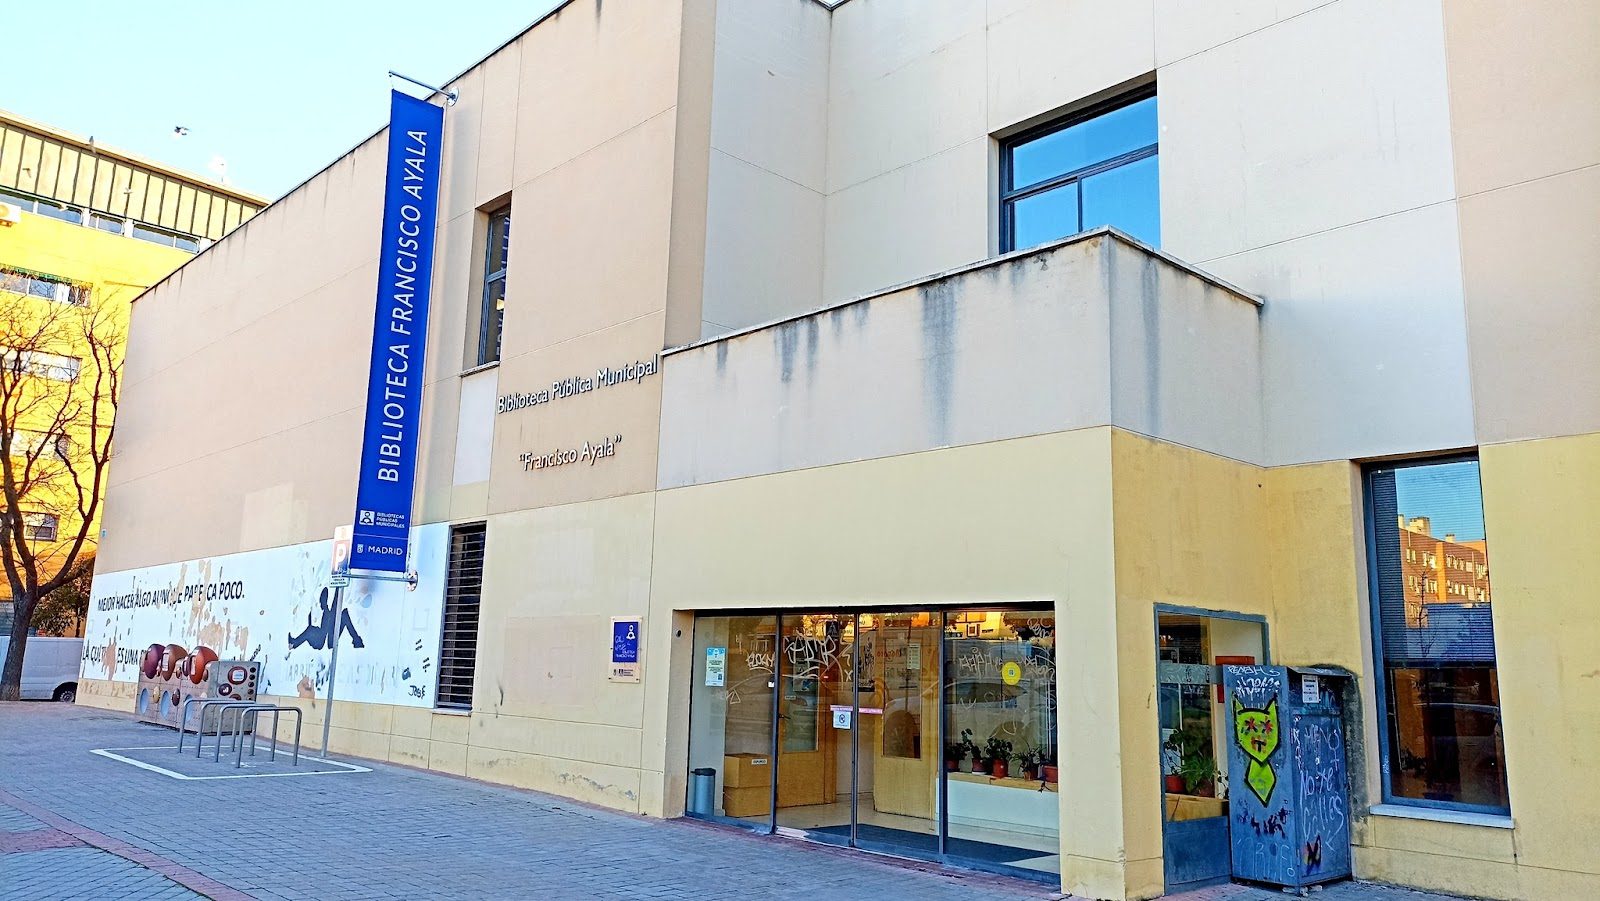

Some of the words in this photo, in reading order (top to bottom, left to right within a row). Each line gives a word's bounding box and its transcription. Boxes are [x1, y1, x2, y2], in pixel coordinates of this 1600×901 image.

[403, 130, 427, 200] AYALA
[391, 205, 421, 335] FRANCISCO
[498, 390, 549, 414] Biblioteca
[552, 376, 592, 400] Pública
[596, 354, 658, 389] Municipal
[378, 345, 409, 482] BIBLIOTECA
[376, 512, 404, 520] BIBLIOTECAS
[376, 521, 405, 529] MUNICIPALES
[335, 543, 347, 572] P
[368, 545, 403, 556] MADRID
[98, 596, 115, 611] MEJOR
[115, 593, 135, 610] HACER
[134, 591, 152, 608] ALGO
[184, 582, 217, 602] PARECA
[219, 580, 245, 600] POCO.
[117, 647, 125, 664] ES
[125, 648, 138, 665] UNA
